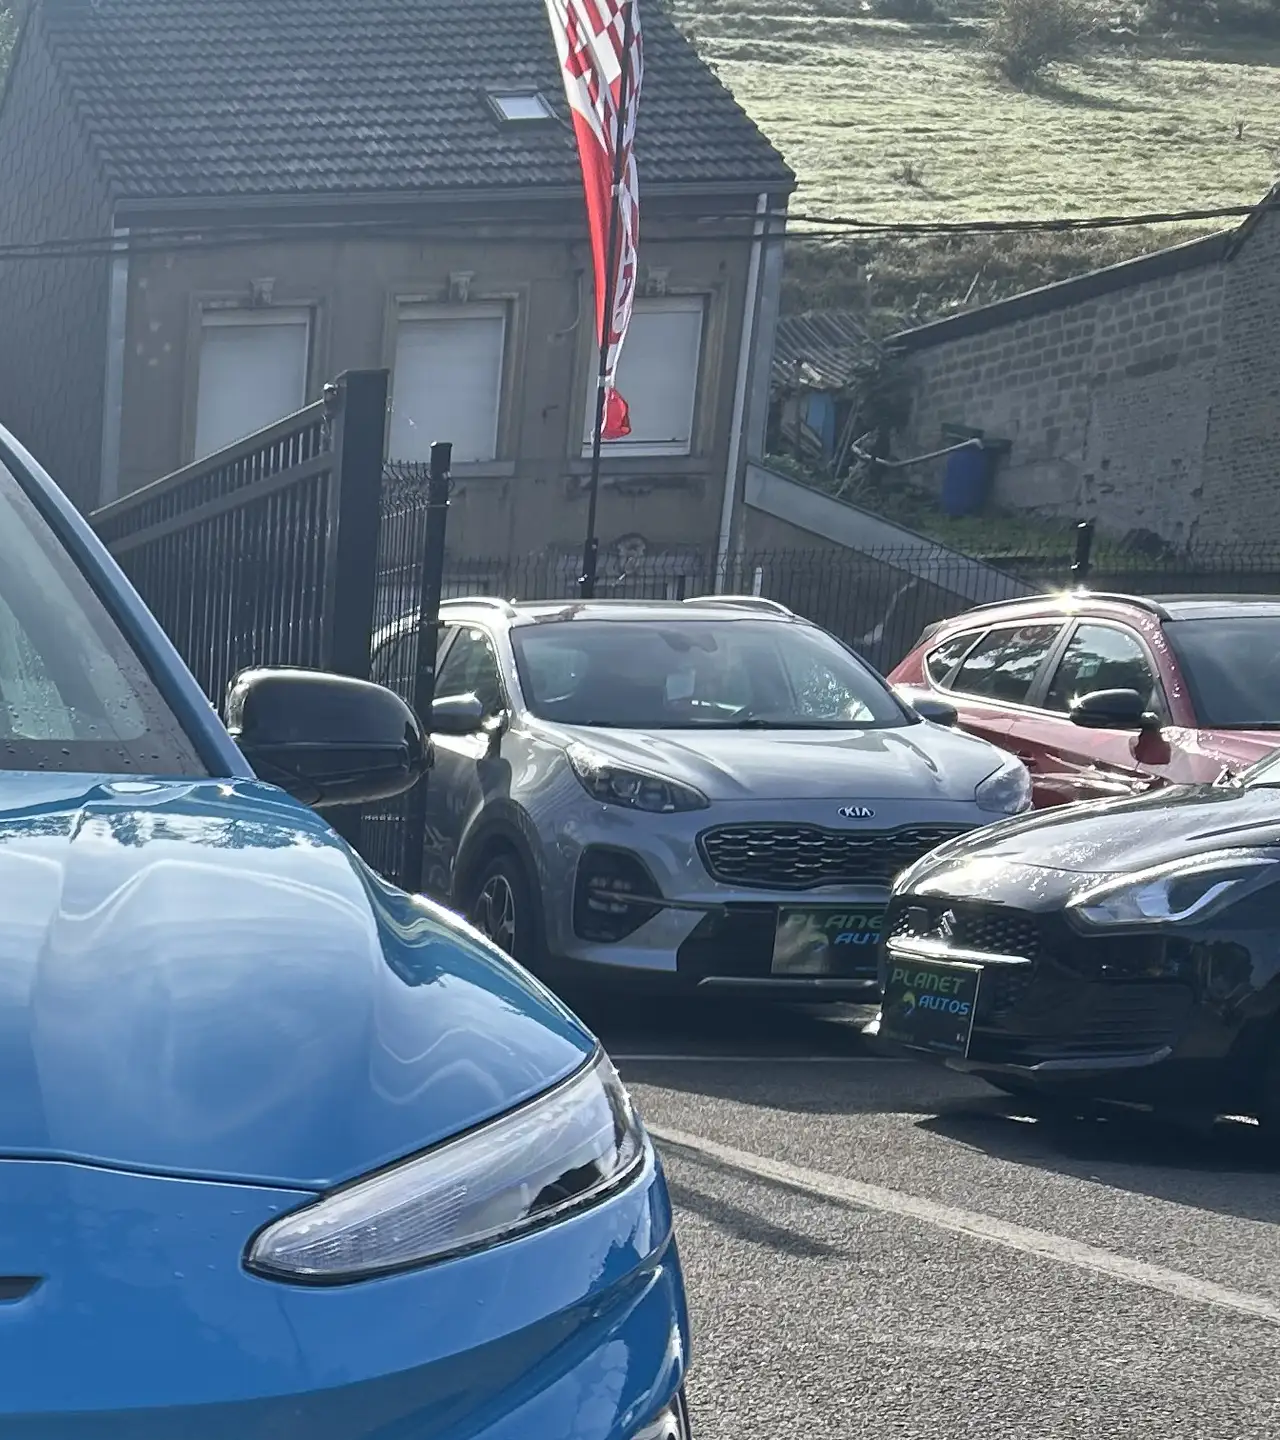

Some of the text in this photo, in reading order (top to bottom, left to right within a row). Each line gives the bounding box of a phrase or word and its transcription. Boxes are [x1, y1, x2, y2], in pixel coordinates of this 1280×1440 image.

[844, 807, 871, 816] KIA
[785, 913, 884, 930] PLANE
[834, 931, 882, 945] AUT
[891, 968, 967, 994] PLANET
[918, 995, 971, 1016] AUTOS
